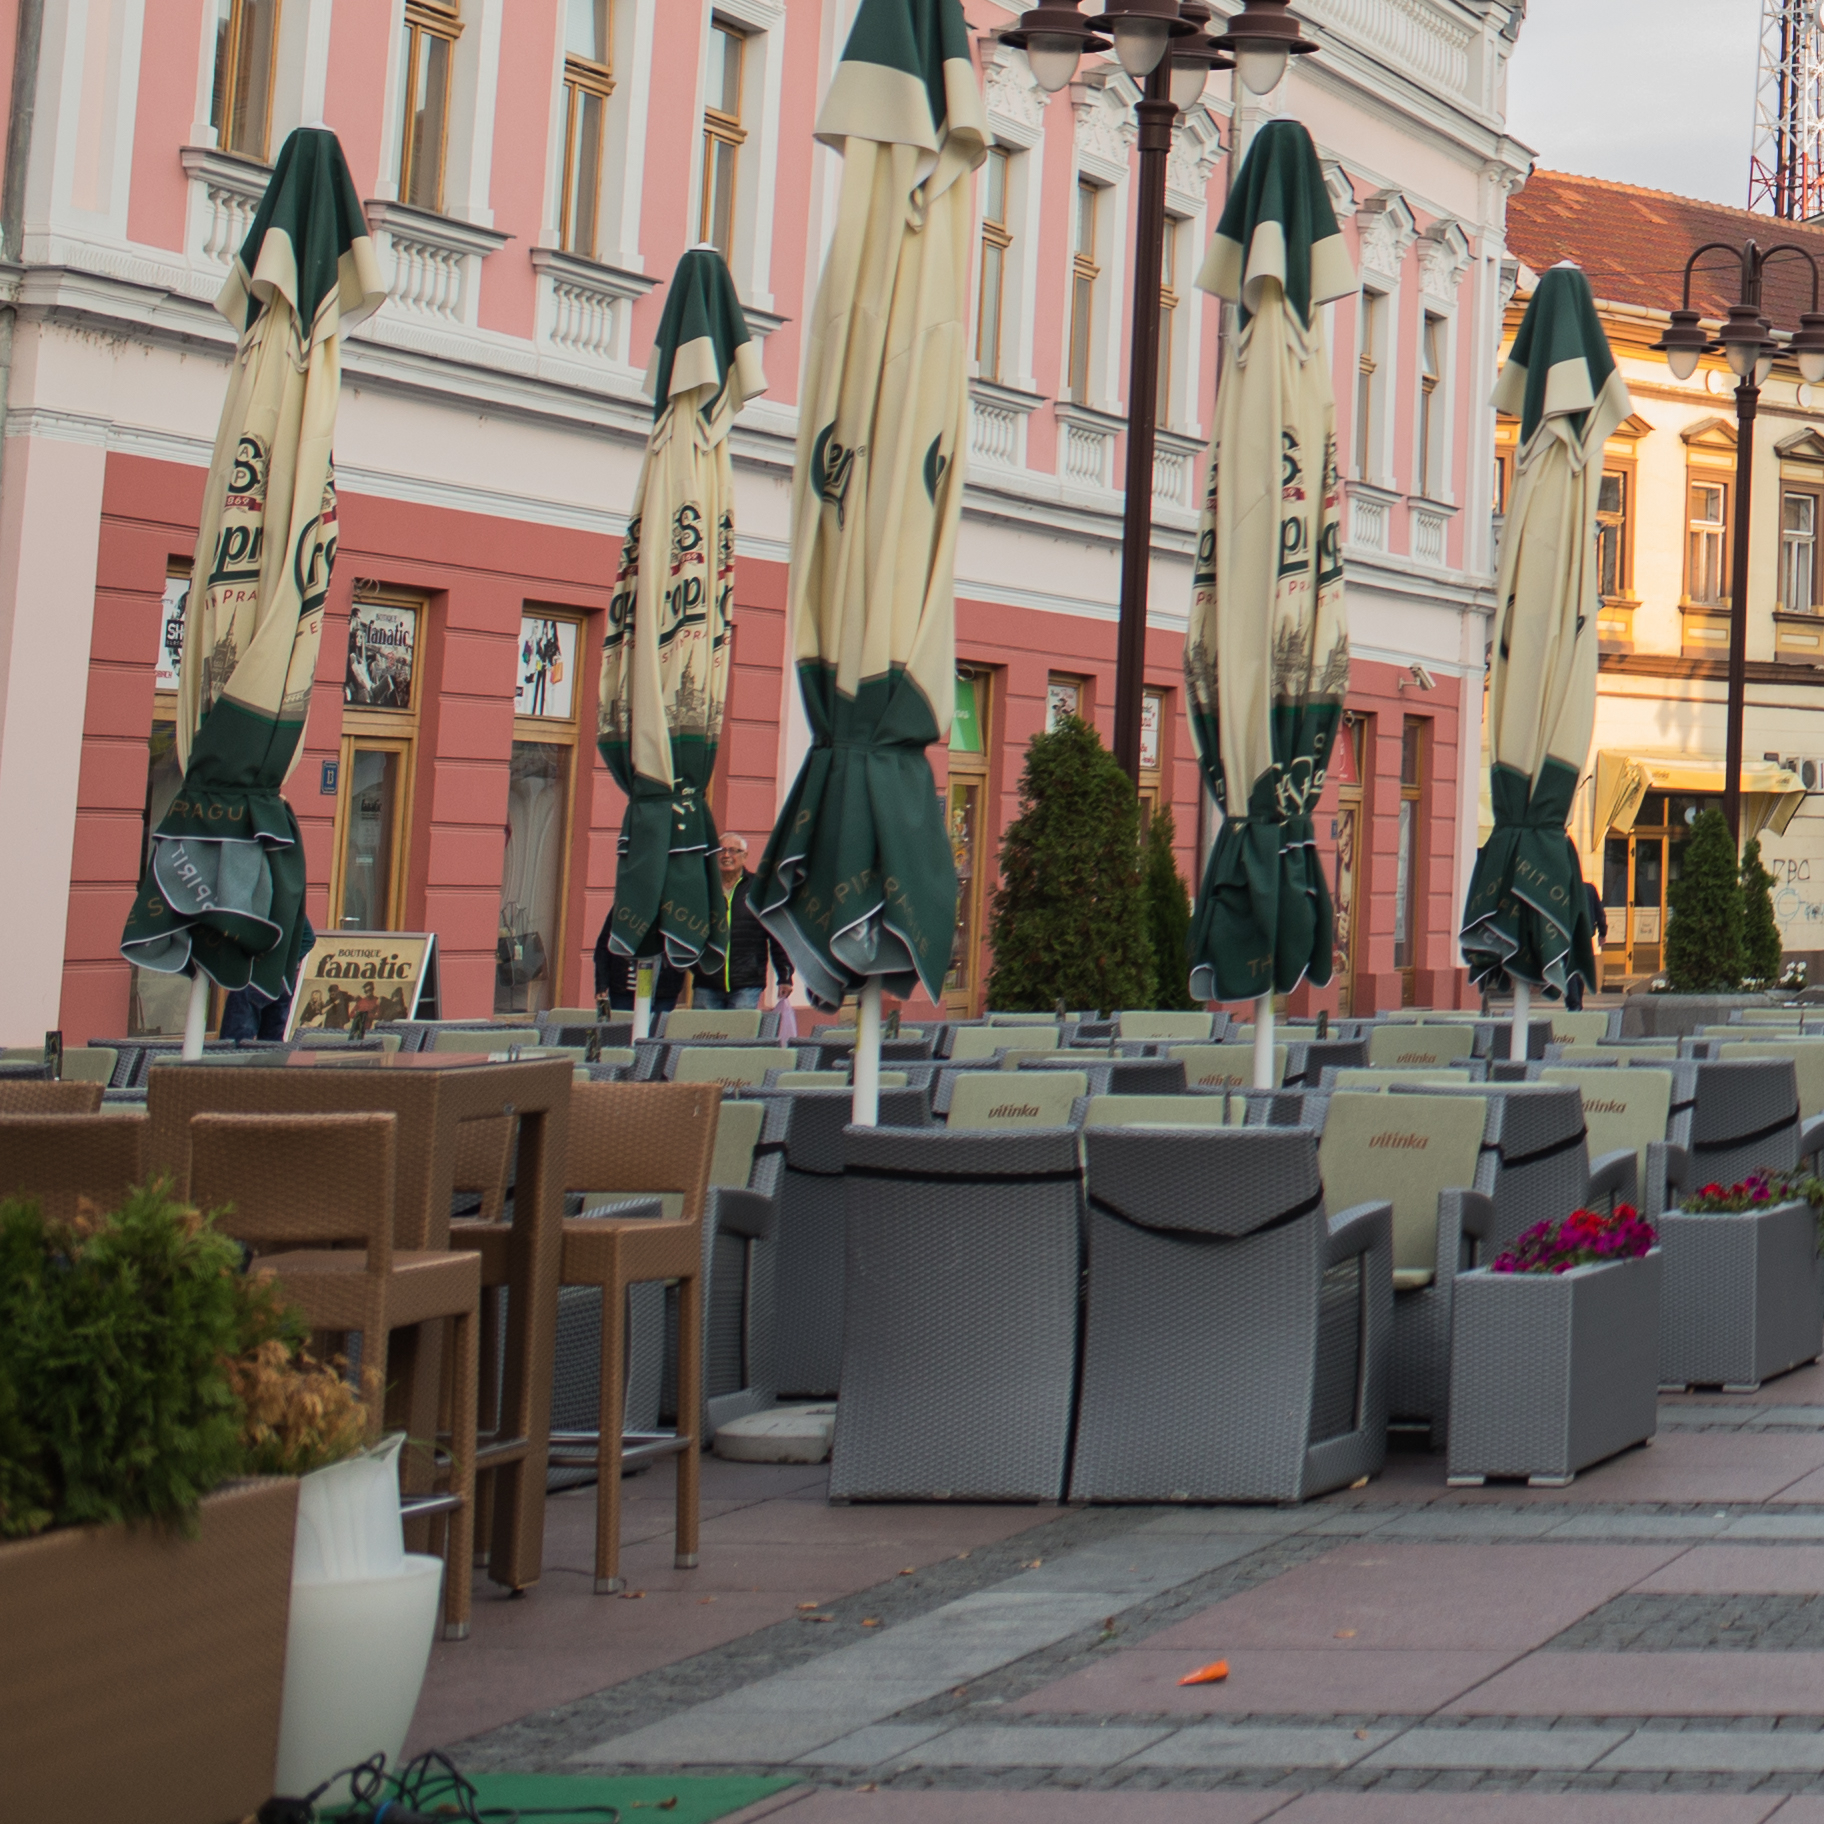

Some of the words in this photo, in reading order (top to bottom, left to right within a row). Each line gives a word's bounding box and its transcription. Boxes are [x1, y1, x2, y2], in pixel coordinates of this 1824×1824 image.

[338, 948, 382, 959] BOUTIQUE
[314, 953, 412, 980] fanatic
[988, 1103, 1041, 1118] vitinka
[1369, 1131, 1429, 1150] vitinka
